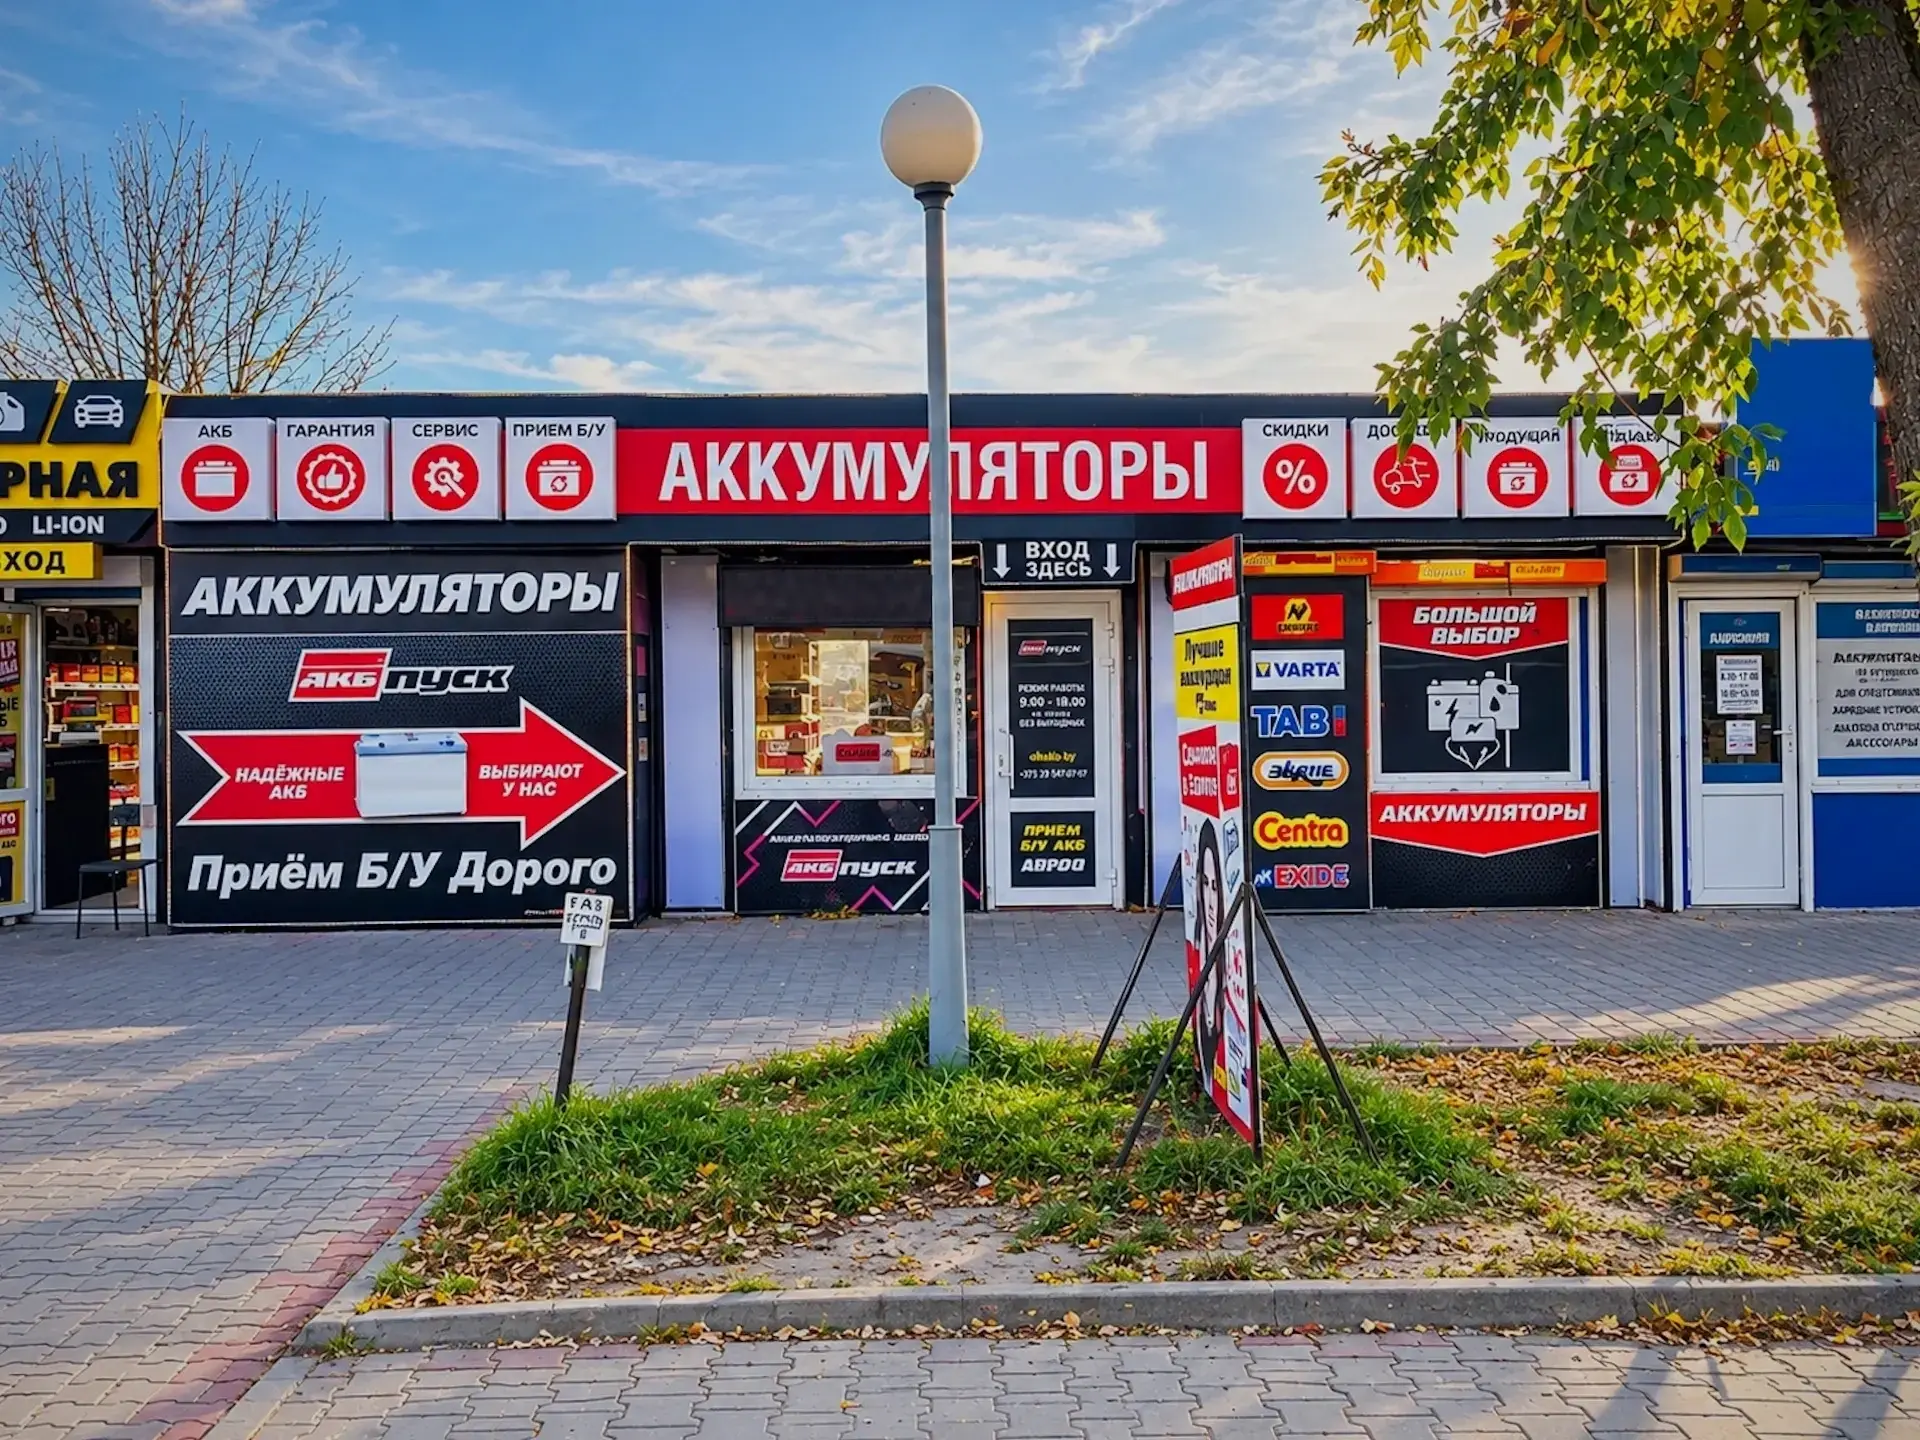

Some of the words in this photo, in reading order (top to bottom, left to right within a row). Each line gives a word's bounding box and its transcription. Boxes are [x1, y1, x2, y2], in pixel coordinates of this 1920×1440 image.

[198, 425, 233, 438] АКБ
[286, 424, 375, 438] ГАРАНТИЯ
[412, 424, 479, 438] СЕРВИС
[513, 424, 572, 437] ПРИЕМ
[577, 424, 606, 438] Б/У
[1262, 424, 1329, 439] СКИДКИ
[32, 515, 105, 535] LI-ION
[1025, 541, 1090, 559] ВХОД
[0, 551, 66, 574] ХОД
[1025, 562, 1093, 580] ЗДЕСЬ
[181, 572, 620, 616] АККУМУЛЯТОРЫ
[1412, 602, 1537, 624] БОЛЬШОЙ
[1430, 627, 1521, 645] ВЫБОР
[1274, 662, 1340, 677] VARTA
[1019, 697, 1045, 708] 9.00
[1056, 696, 1086, 707] 18.00
[1251, 706, 1329, 737] TAB
[235, 763, 344, 782] НАДЁЖНЫЕ
[479, 763, 583, 780] ВЫБИРАЮТ
[269, 785, 307, 800] АКБ
[502, 782, 516, 797] У
[521, 781, 556, 796] НАС
[1379, 803, 1587, 823] АККУМУЛЯТОРЫ
[1259, 817, 1342, 843] Centra
[1053, 839, 1086, 851] АКБ
[187, 854, 343, 899] Приём
[357, 852, 441, 889] Б/У
[447, 851, 616, 895] Дорого
[1274, 864, 1349, 888] EXIDE
